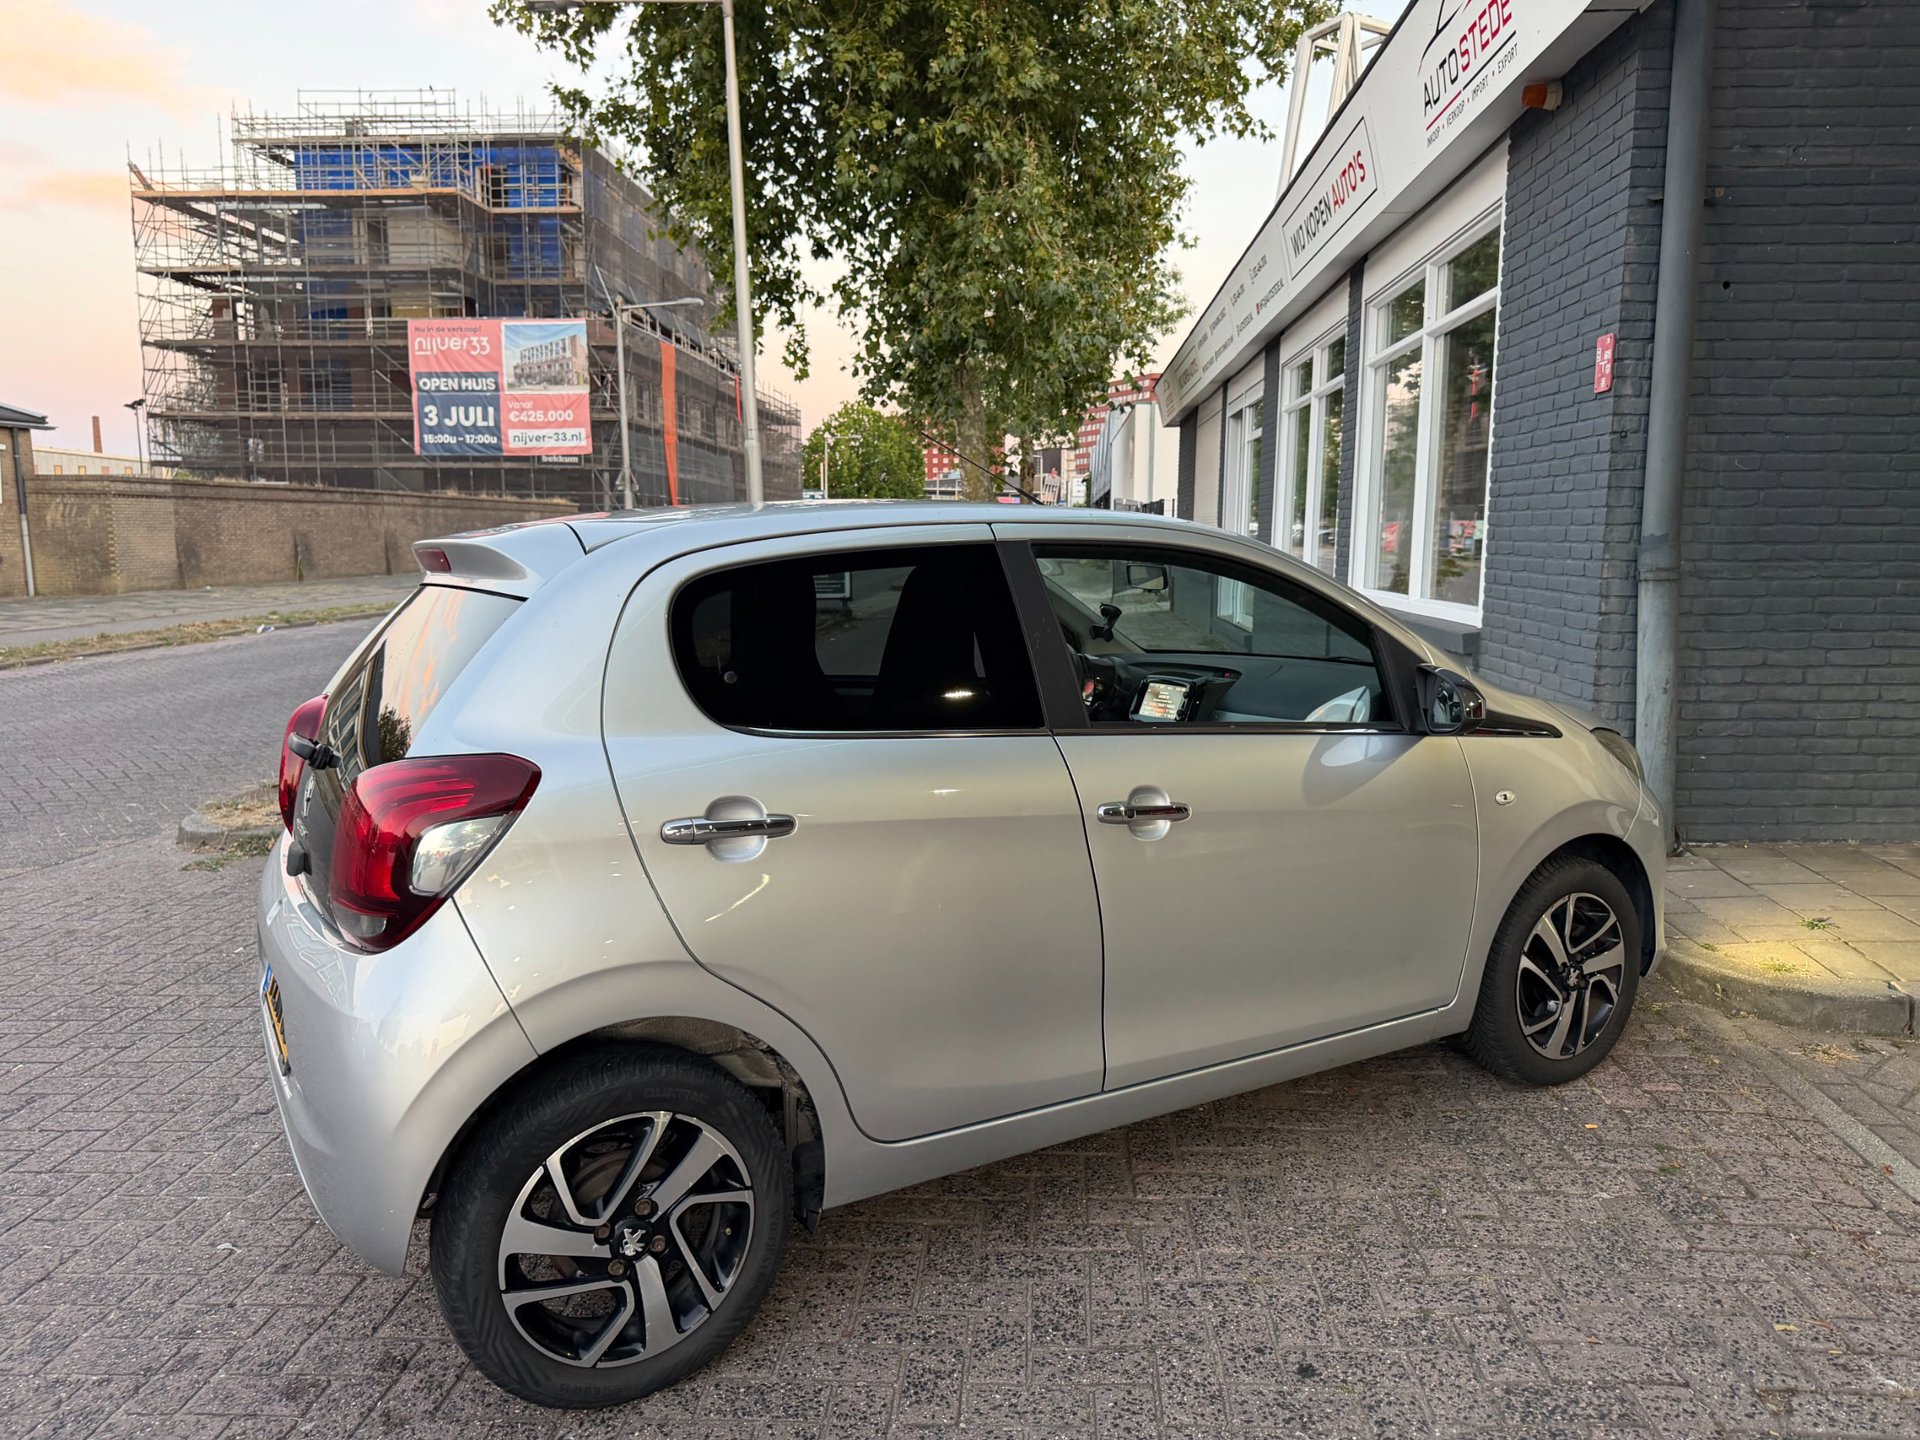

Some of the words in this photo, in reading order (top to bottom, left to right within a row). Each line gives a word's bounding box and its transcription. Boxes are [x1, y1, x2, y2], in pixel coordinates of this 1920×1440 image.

[1497, 43, 1518, 74] EXPORT
[1290, 224, 1306, 259] WIJ
[1304, 192, 1333, 245] KOPEN
[1331, 150, 1366, 214] AUTO'S
[435, 325, 445, 333] de
[447, 325, 482, 334] verkoop!
[419, 378, 458, 391] OPEN
[461, 377, 496, 391] HUIS
[423, 405, 439, 427] 3
[444, 406, 496, 428] JULI
[509, 409, 574, 423] €425.000
[423, 434, 457, 444] 15:00u
[465, 434, 498, 444] 17:00u
[513, 431, 582, 446] nijver-33.nl
